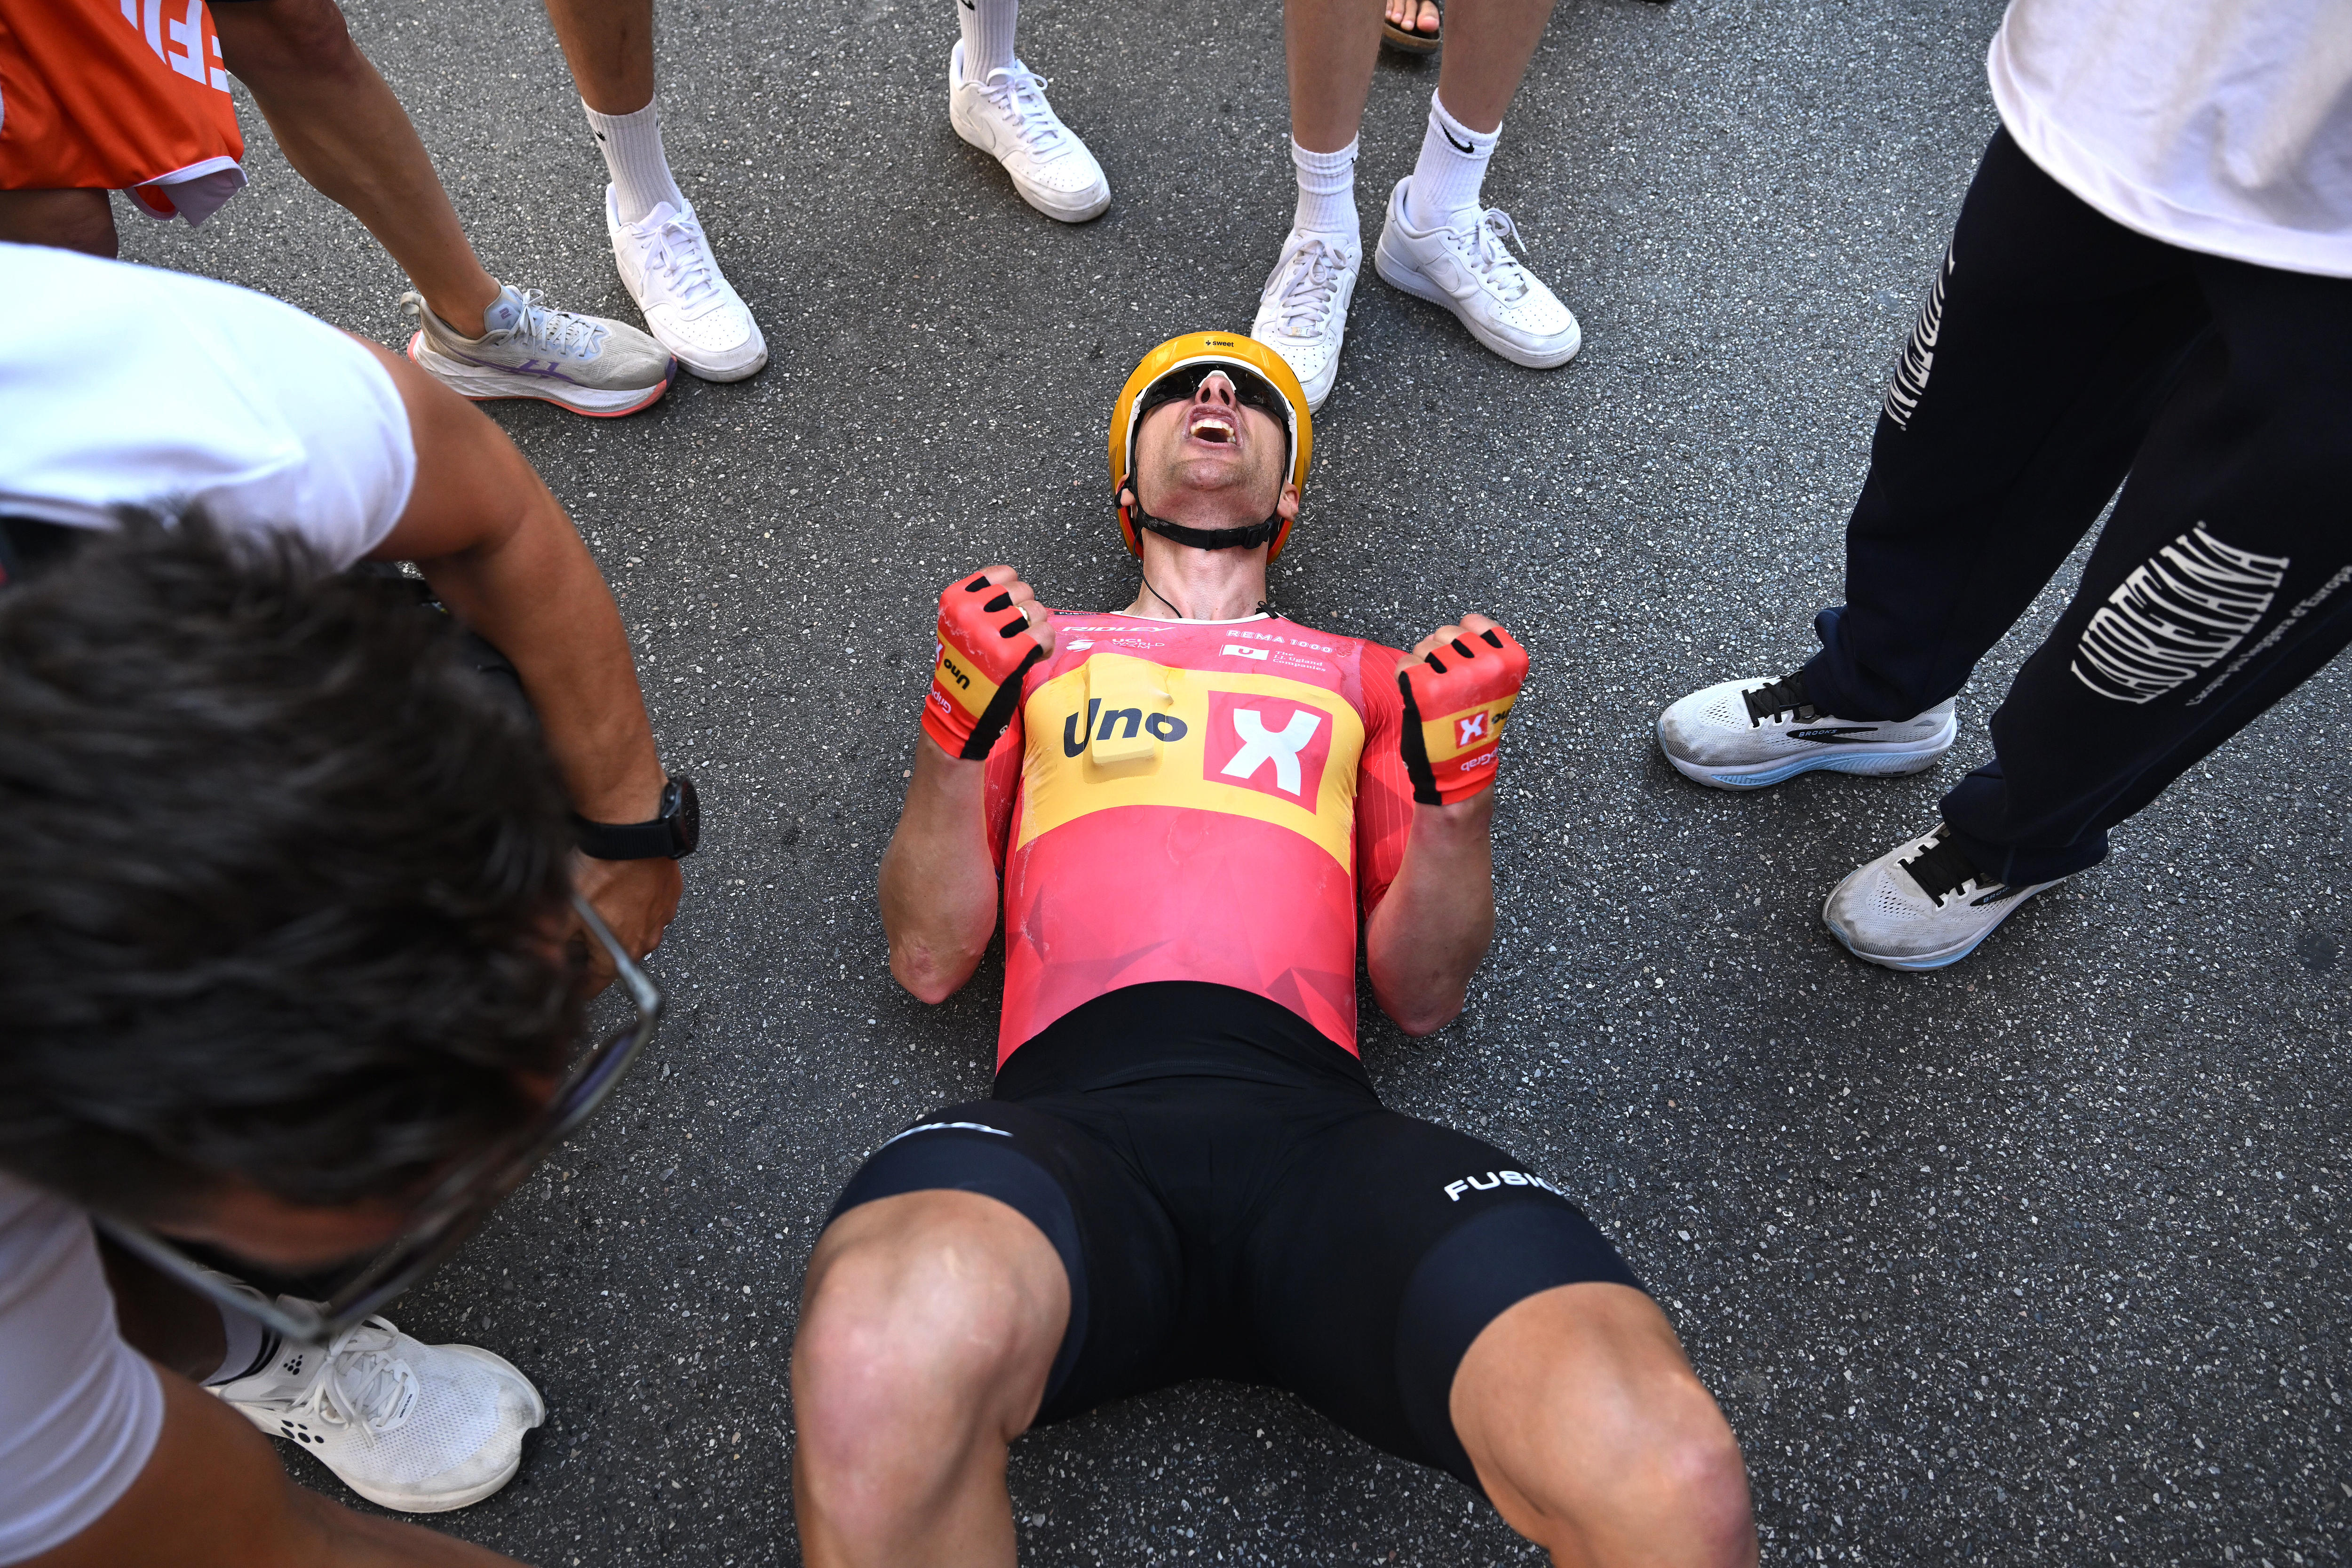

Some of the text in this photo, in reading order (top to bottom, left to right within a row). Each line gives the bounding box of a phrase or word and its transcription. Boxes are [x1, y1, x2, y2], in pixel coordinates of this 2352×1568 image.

[2071, 527, 2289, 705] LAURETANA
[1226, 629, 1333, 653] REMA 1000
[1272, 659, 1326, 672] Companies
[1289, 657, 1323, 666] Ugland
[944, 659, 970, 690] Uno
[1460, 713, 1485, 745] X
[1798, 729, 1838, 738] BROOKS
[1063, 698, 1322, 796] Uno X
[1983, 886, 2010, 903] BROO
